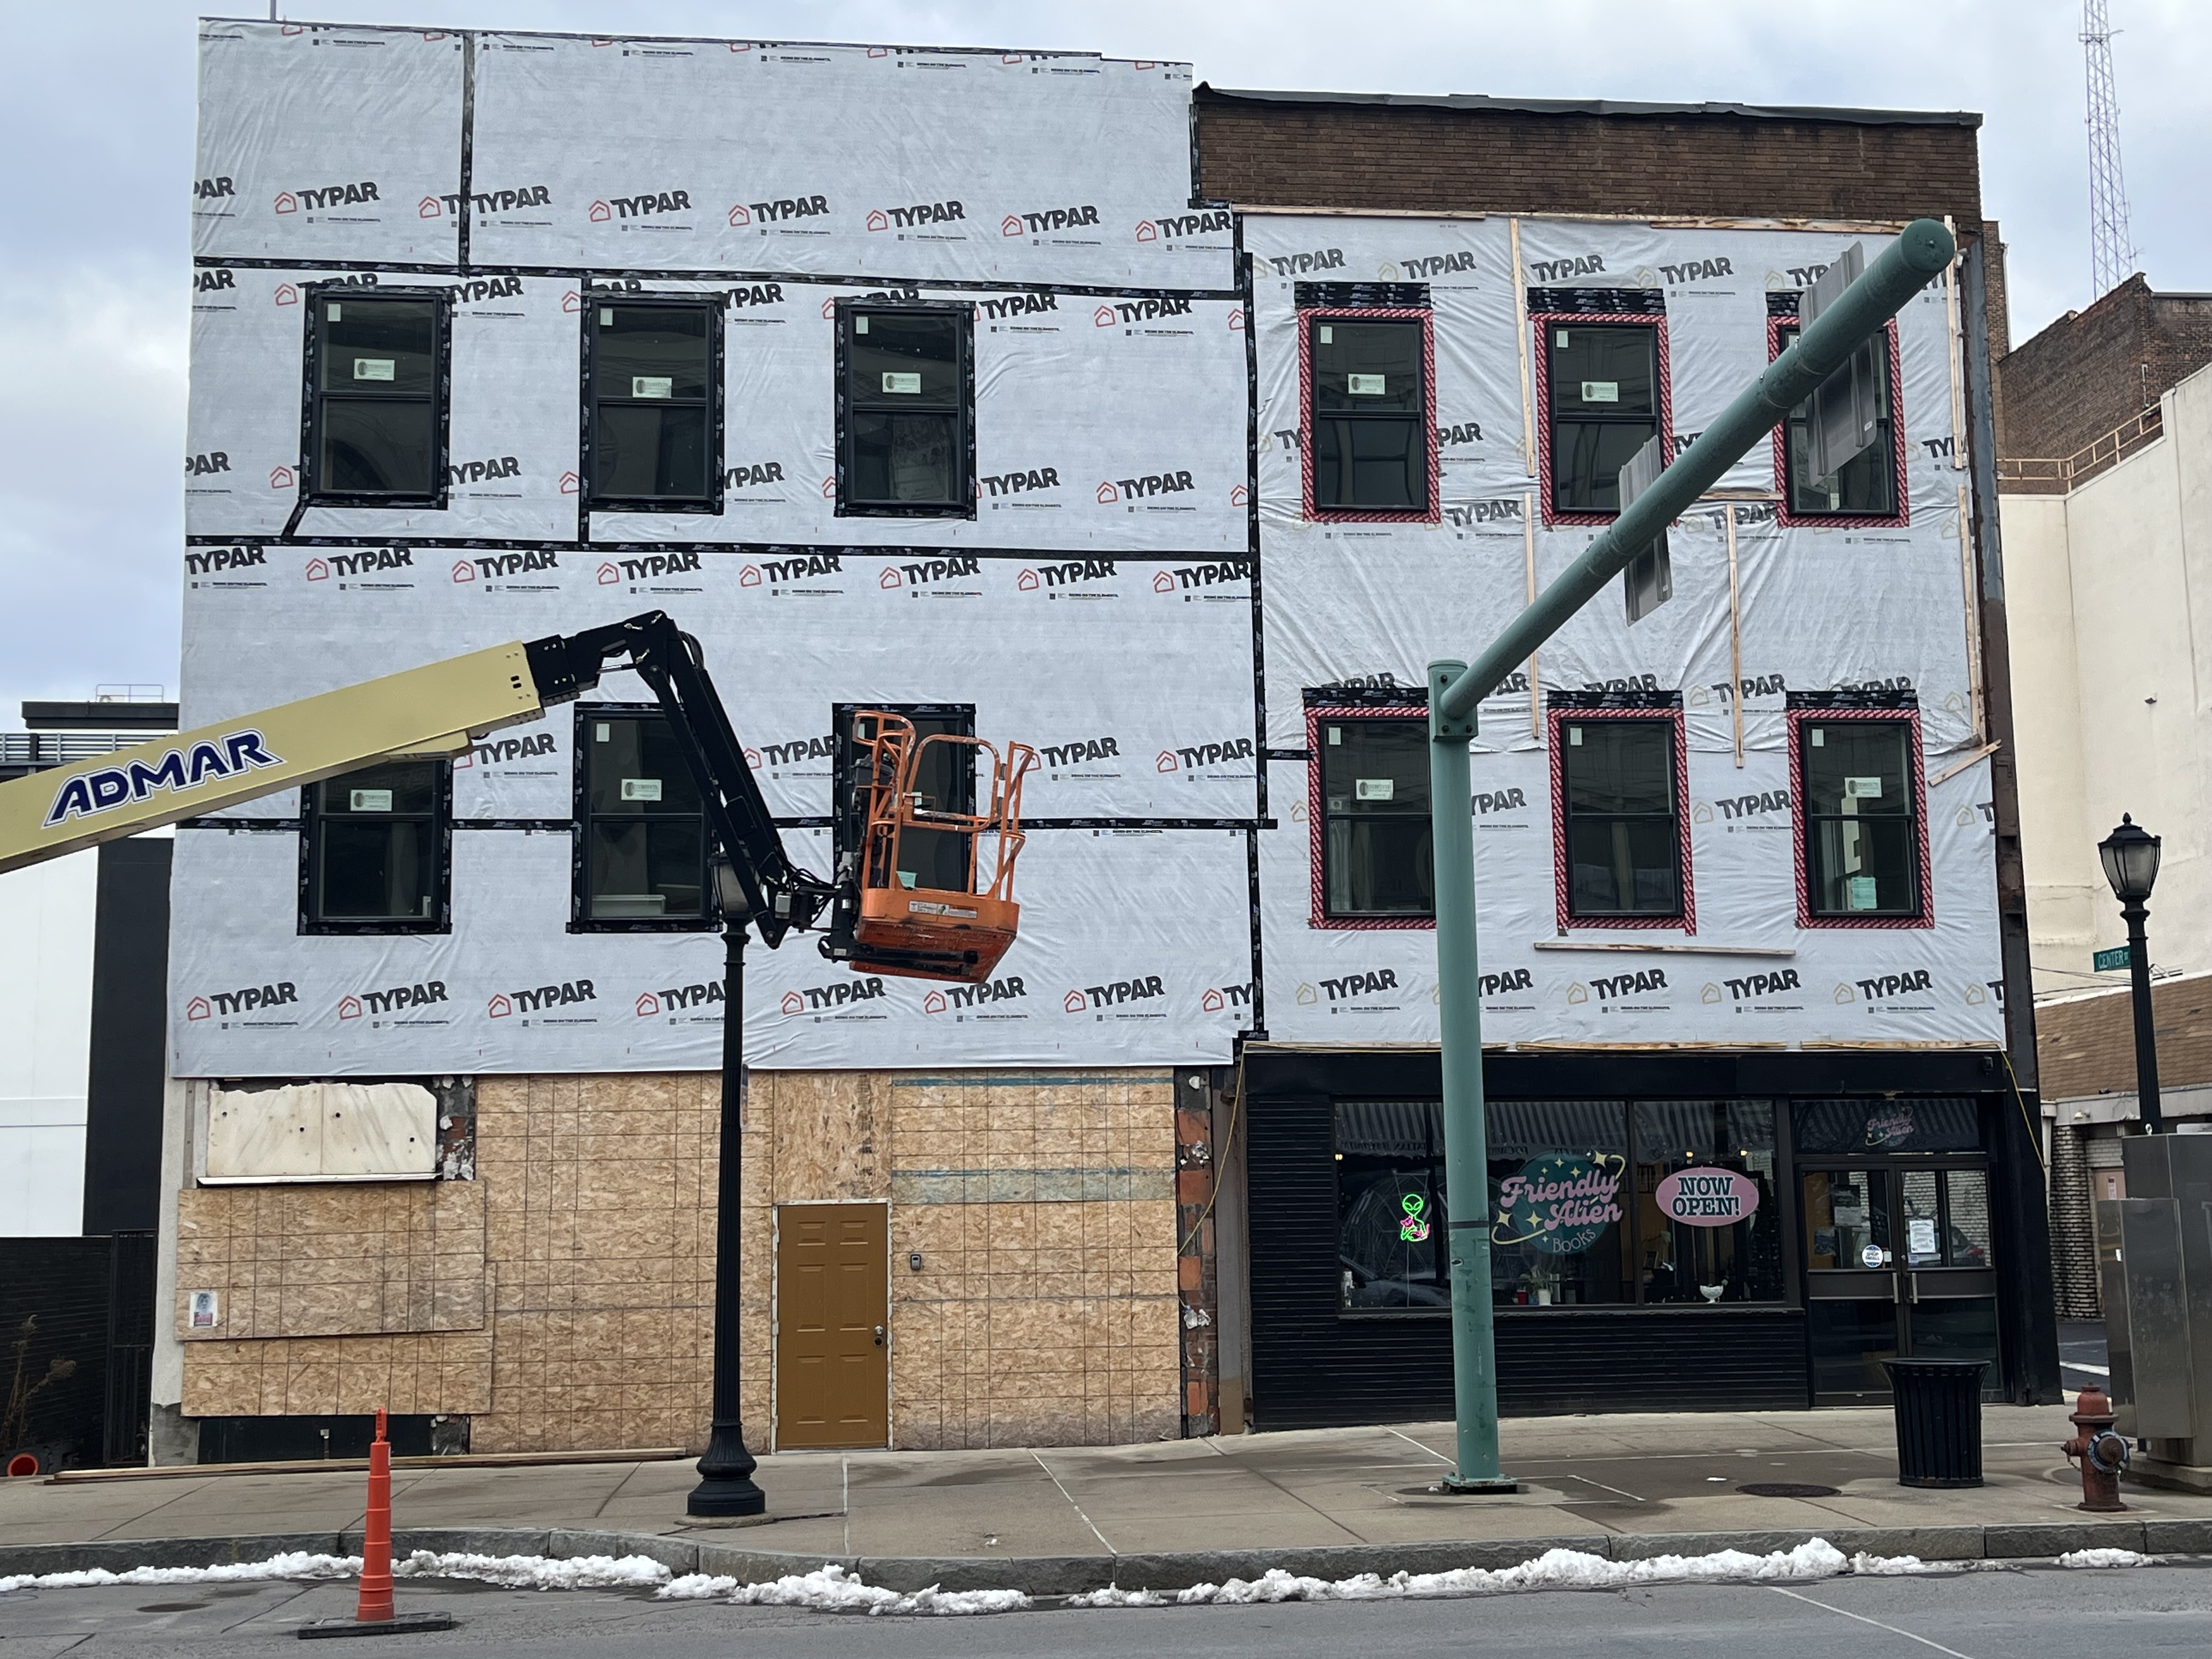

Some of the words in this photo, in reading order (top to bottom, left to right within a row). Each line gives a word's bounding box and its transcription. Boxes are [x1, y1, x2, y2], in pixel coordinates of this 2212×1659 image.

[295, 182, 381, 210] TYPAR
[470, 185, 552, 214] TYPAR
[610, 190, 691, 218] TYPAR
[748, 195, 830, 223] TYPAR
[885, 201, 966, 228] TYPAR
[1021, 205, 1101, 233] TYPAR
[1154, 210, 1233, 238] TYPAR
[1268, 248, 1346, 276] TYPAR
[1400, 251, 1477, 279] TYPAR
[1530, 255, 1606, 282] TYPAR
[1658, 257, 1734, 285] TYPAR
[723, 284, 785, 309] YPAR
[978, 292, 1058, 319] TYPAR
[1113, 298, 1193, 323] TYPAR
[1438, 422, 1484, 446] PAR
[725, 462, 785, 490] YPAR
[980, 467, 1061, 496] TYPAR
[1115, 471, 1195, 500] TYPAR
[1444, 500, 1523, 527] TYPAR
[187, 548, 267, 575] TYPAR
[327, 549, 414, 577] TYPAR
[473, 551, 559, 578] TYPAR
[617, 552, 703, 580] TYPAR
[760, 555, 842, 583] TYPAR
[899, 557, 981, 585] TYPAR
[1037, 560, 1118, 586] TYPAR
[1173, 562, 1251, 589] TYPAR
[472, 733, 557, 764] TYPAR
[1039, 737, 1120, 768] TYPAR
[1175, 738, 1255, 769] TYPAR
[44, 730, 284, 827] ADMAR
[1471, 788, 1527, 816] YPAR
[1714, 789, 1792, 820] TYPAR
[2097, 950, 2124, 969] CENTER
[510, 979, 597, 1013] TYPAR
[657, 979, 726, 1011] TYPA
[802, 977, 887, 1009] TYPAR
[944, 976, 1027, 1009] TYPAR
[1084, 975, 1166, 1008] TYPAR
[1318, 969, 1399, 1001] TYPAR
[1479, 968, 1534, 997] YPAR
[1589, 969, 1668, 1000] TYPAR
[1723, 969, 1801, 1000] TYPAR
[1855, 969, 1933, 1000] TYPAR
[209, 982, 298, 1015] TYPAR
[360, 981, 449, 1014] TYPAR
[1499, 1169, 1620, 1208] Friendly
[1677, 1177, 1734, 1196] NOW
[1544, 1199, 1623, 1231] Alien
[1672, 1197, 1740, 1217] OPEN!
